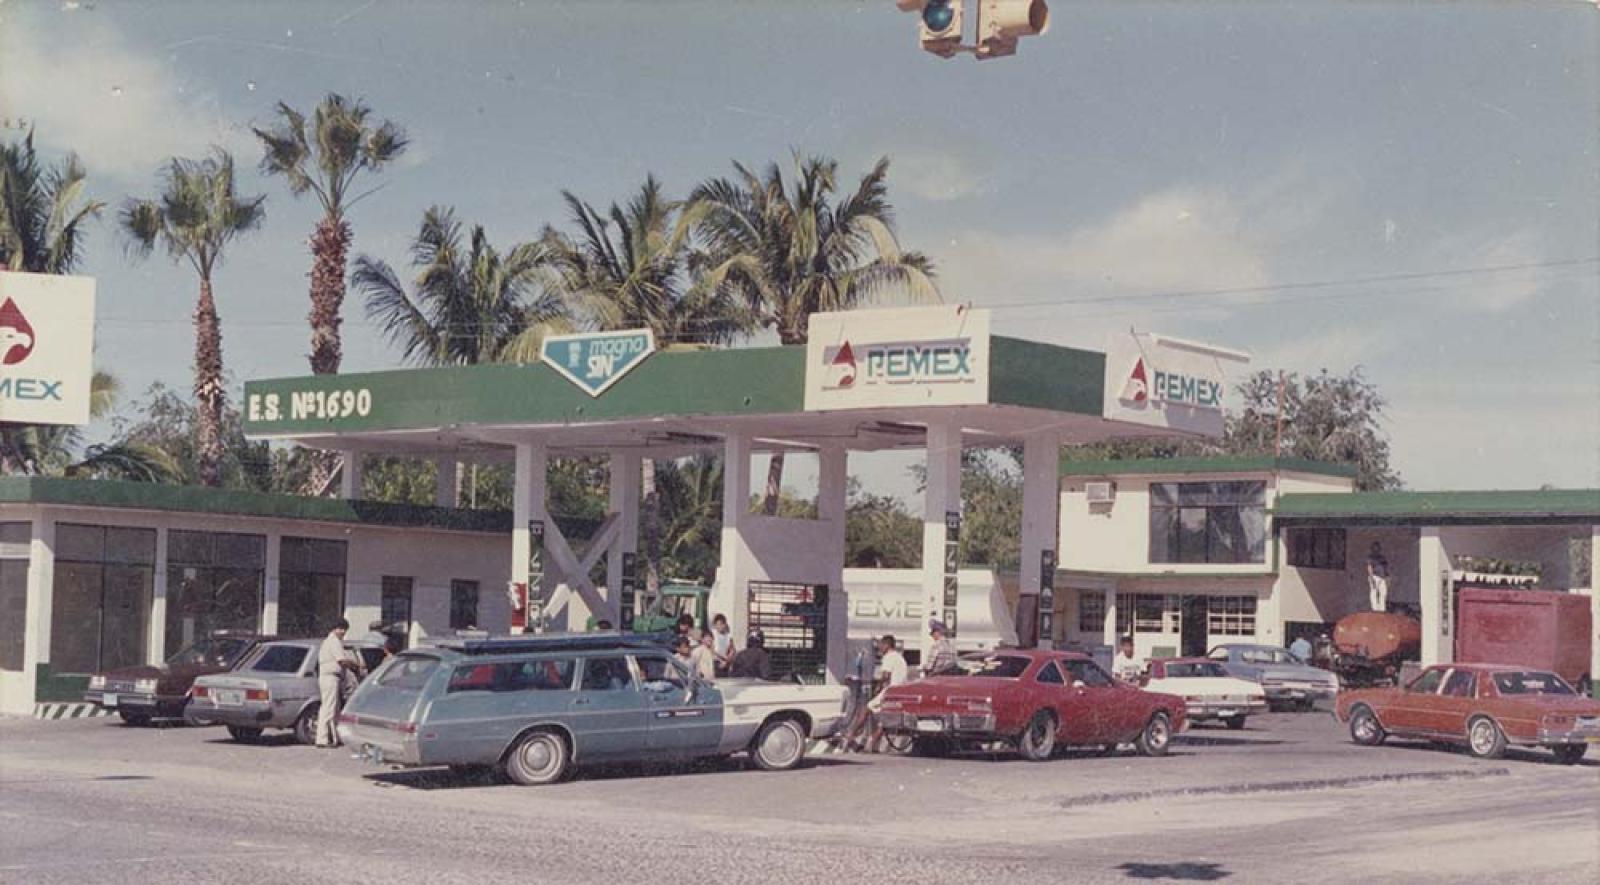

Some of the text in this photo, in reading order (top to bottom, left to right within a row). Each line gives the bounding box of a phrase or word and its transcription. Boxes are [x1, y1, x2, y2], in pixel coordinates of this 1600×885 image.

[586, 355, 614, 379] SIN
[867, 347, 970, 377] PEMEX
[1154, 370, 1219, 406] PEMEX
[249, 393, 282, 421] E.S.
